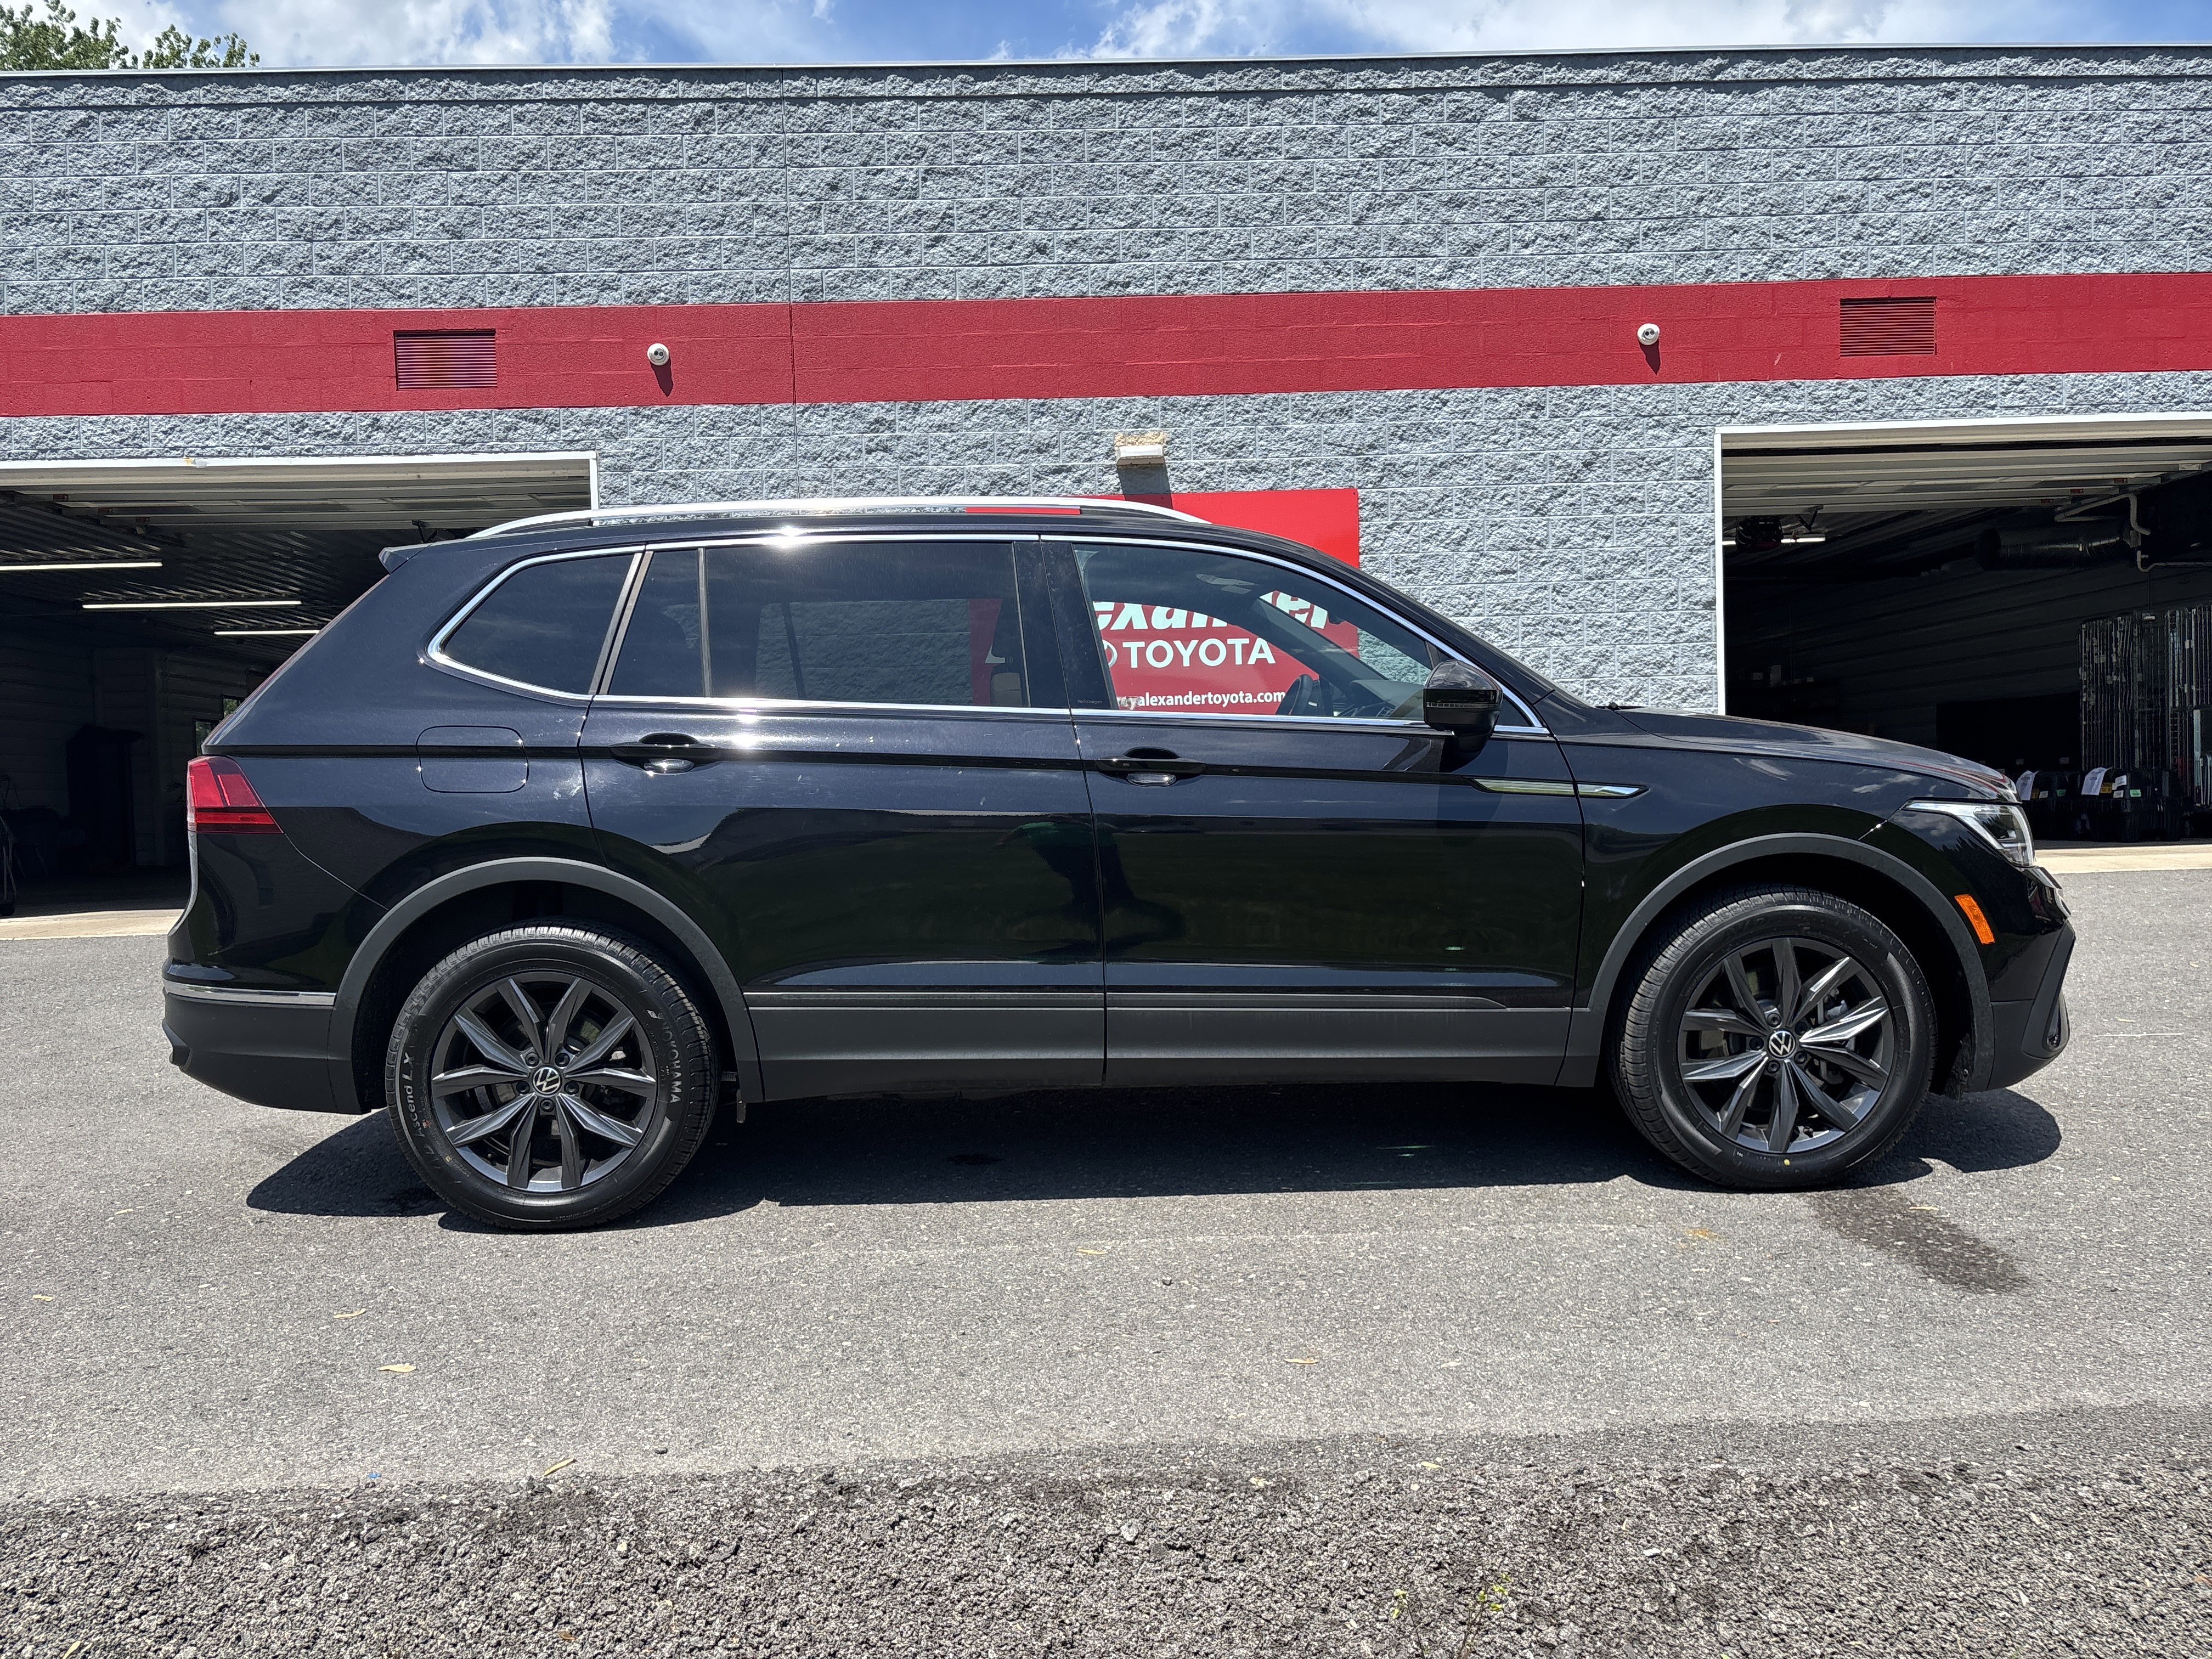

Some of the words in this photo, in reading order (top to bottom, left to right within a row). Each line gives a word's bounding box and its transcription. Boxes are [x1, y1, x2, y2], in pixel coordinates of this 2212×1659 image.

[1122, 638, 1276, 668] TOYOTA
[402, 1051, 415, 1081] LX
[662, 1020, 682, 1104] YOKOHAMA
[405, 1085, 425, 1138] Ascend
